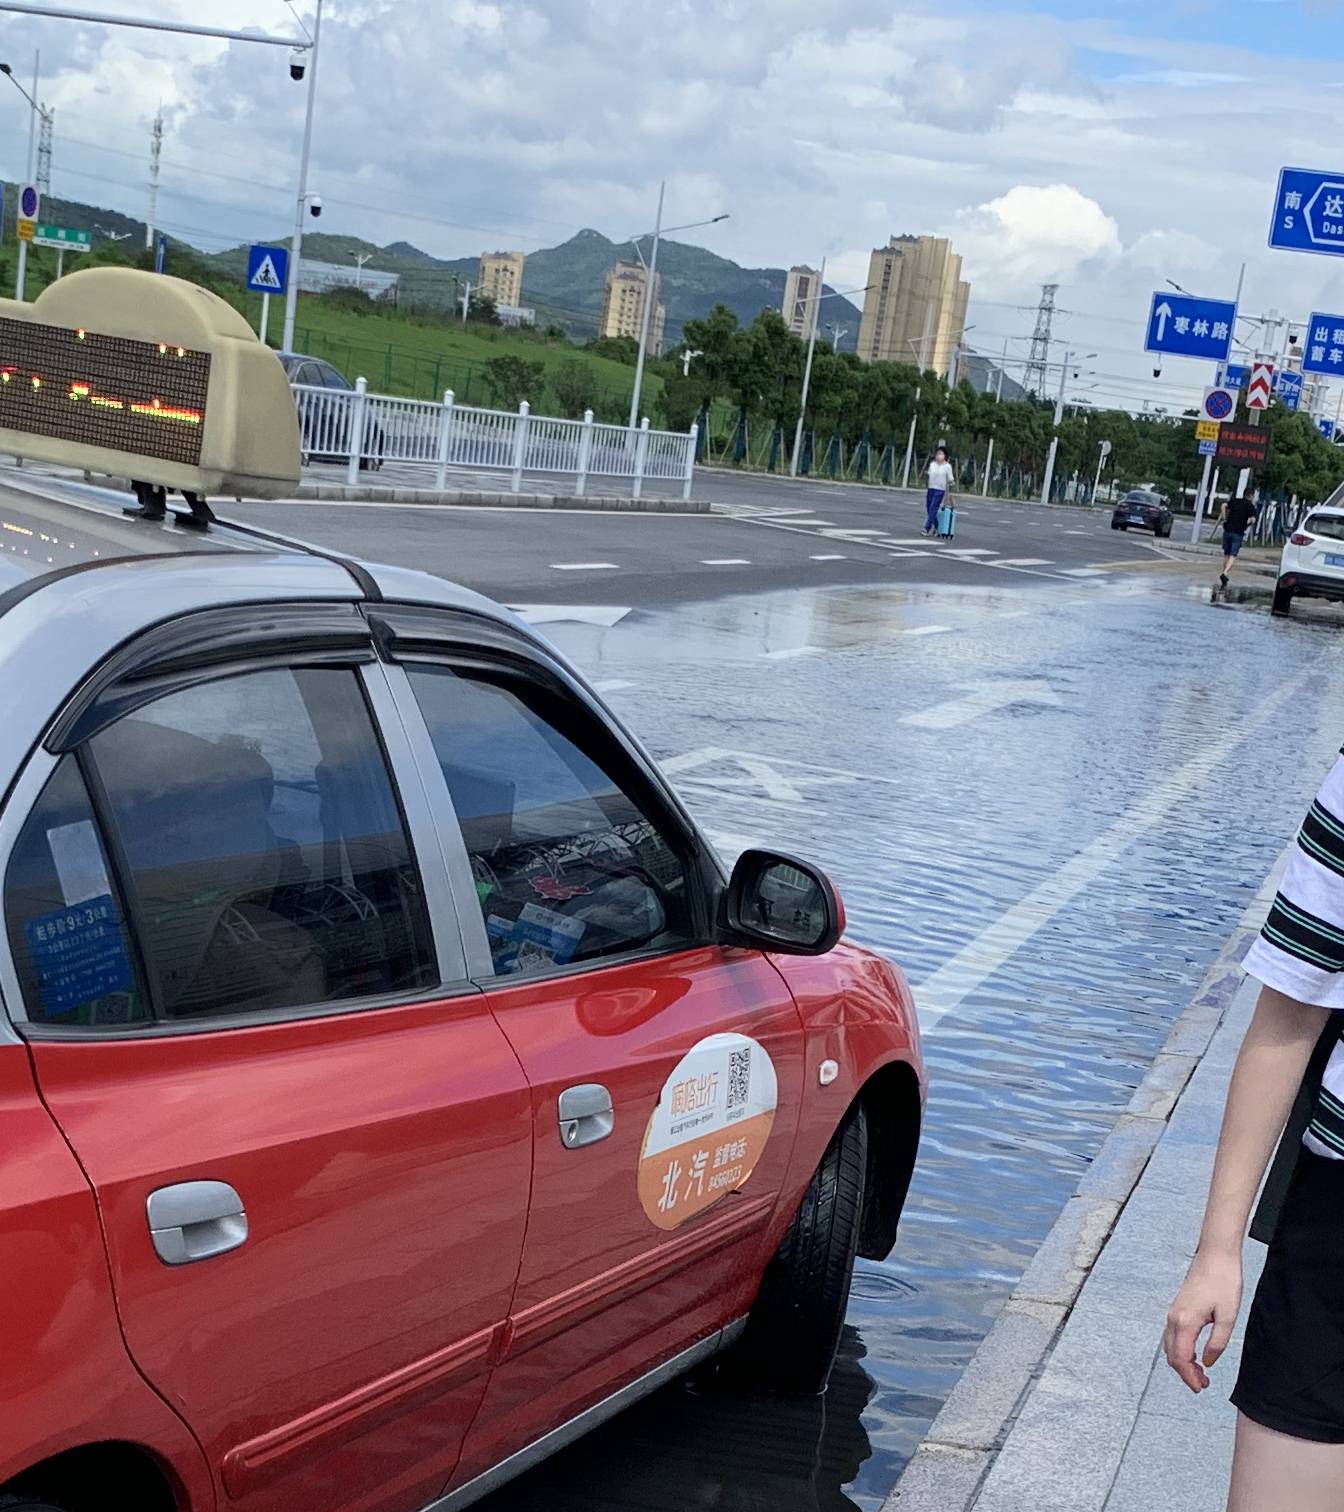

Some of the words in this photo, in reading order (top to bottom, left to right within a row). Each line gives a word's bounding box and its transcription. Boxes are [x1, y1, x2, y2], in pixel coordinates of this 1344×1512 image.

[1284, 191, 1302, 210] 南
[1284, 216, 1294, 229] S
[1173, 316, 1228, 340] 枣林路
[658, 1150, 709, 1212] 北汽
